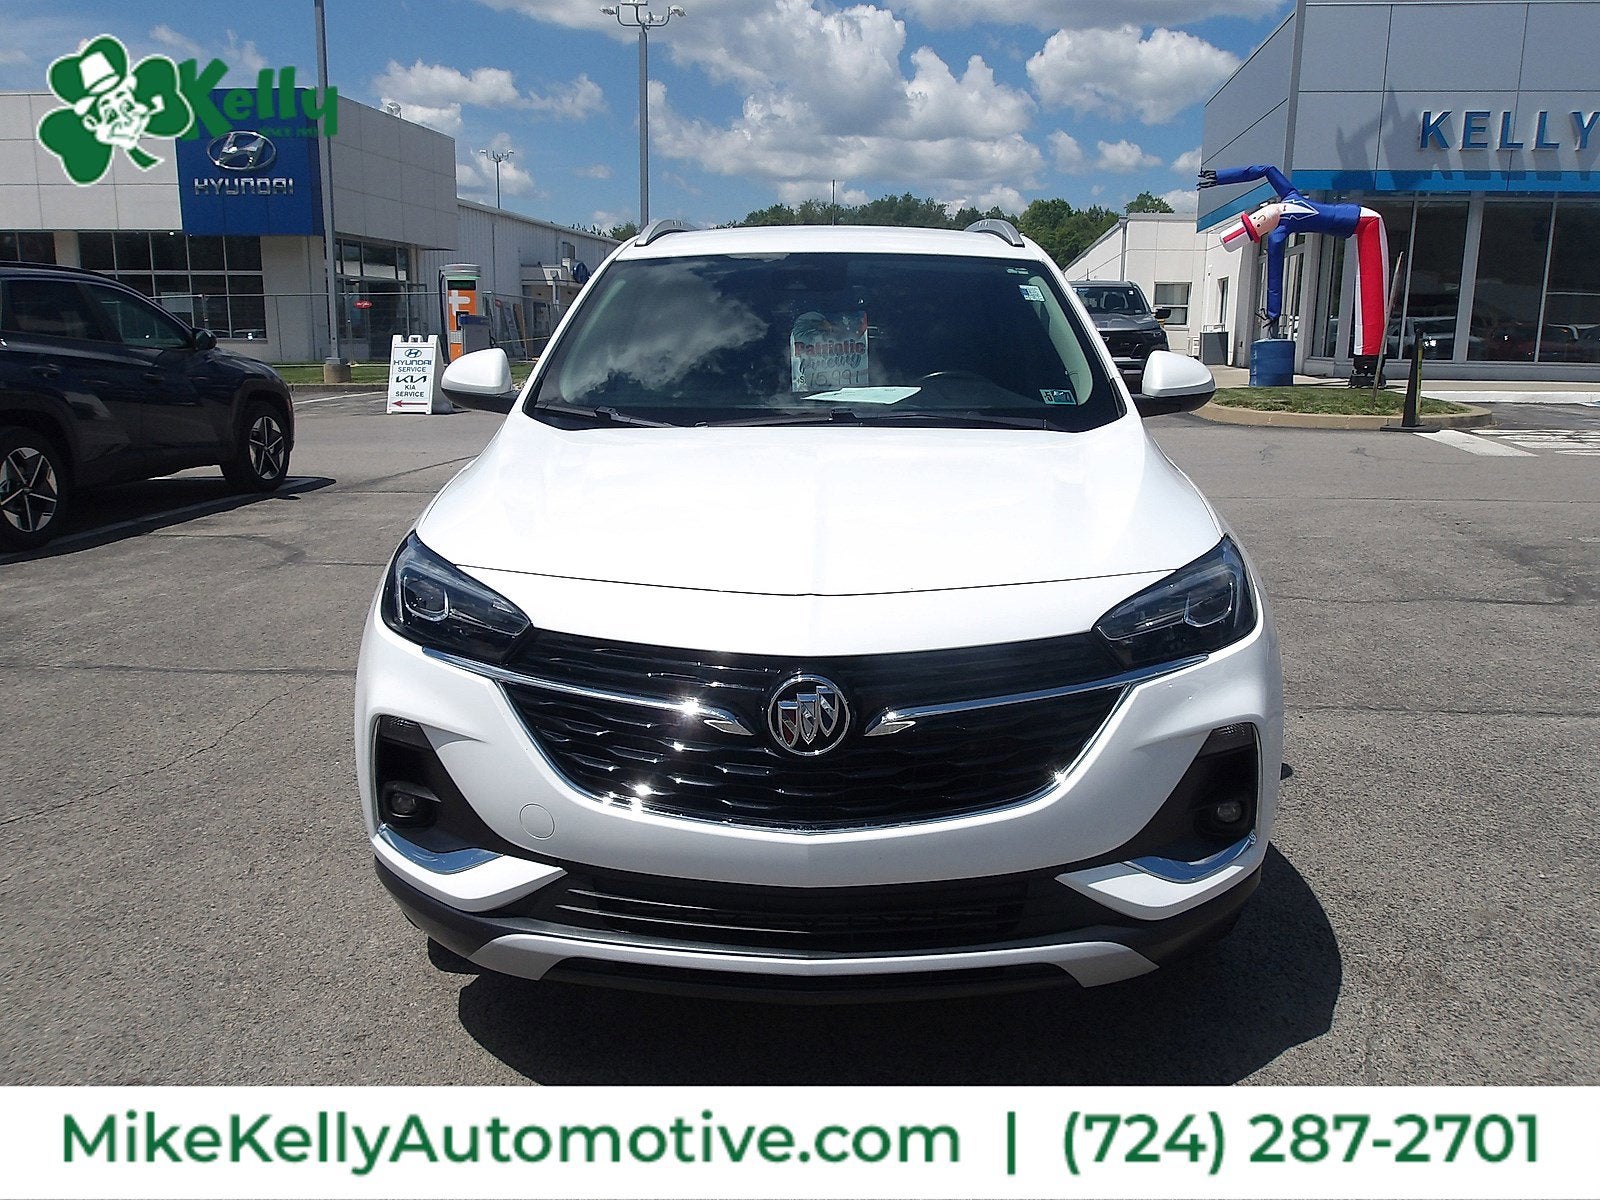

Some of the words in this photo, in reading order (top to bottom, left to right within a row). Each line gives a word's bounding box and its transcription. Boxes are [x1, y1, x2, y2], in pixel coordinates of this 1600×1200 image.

[1420, 110, 1600, 151] KELLY
[193, 177, 294, 196] HYUNDAI
[794, 340, 866, 358] Patriotic
